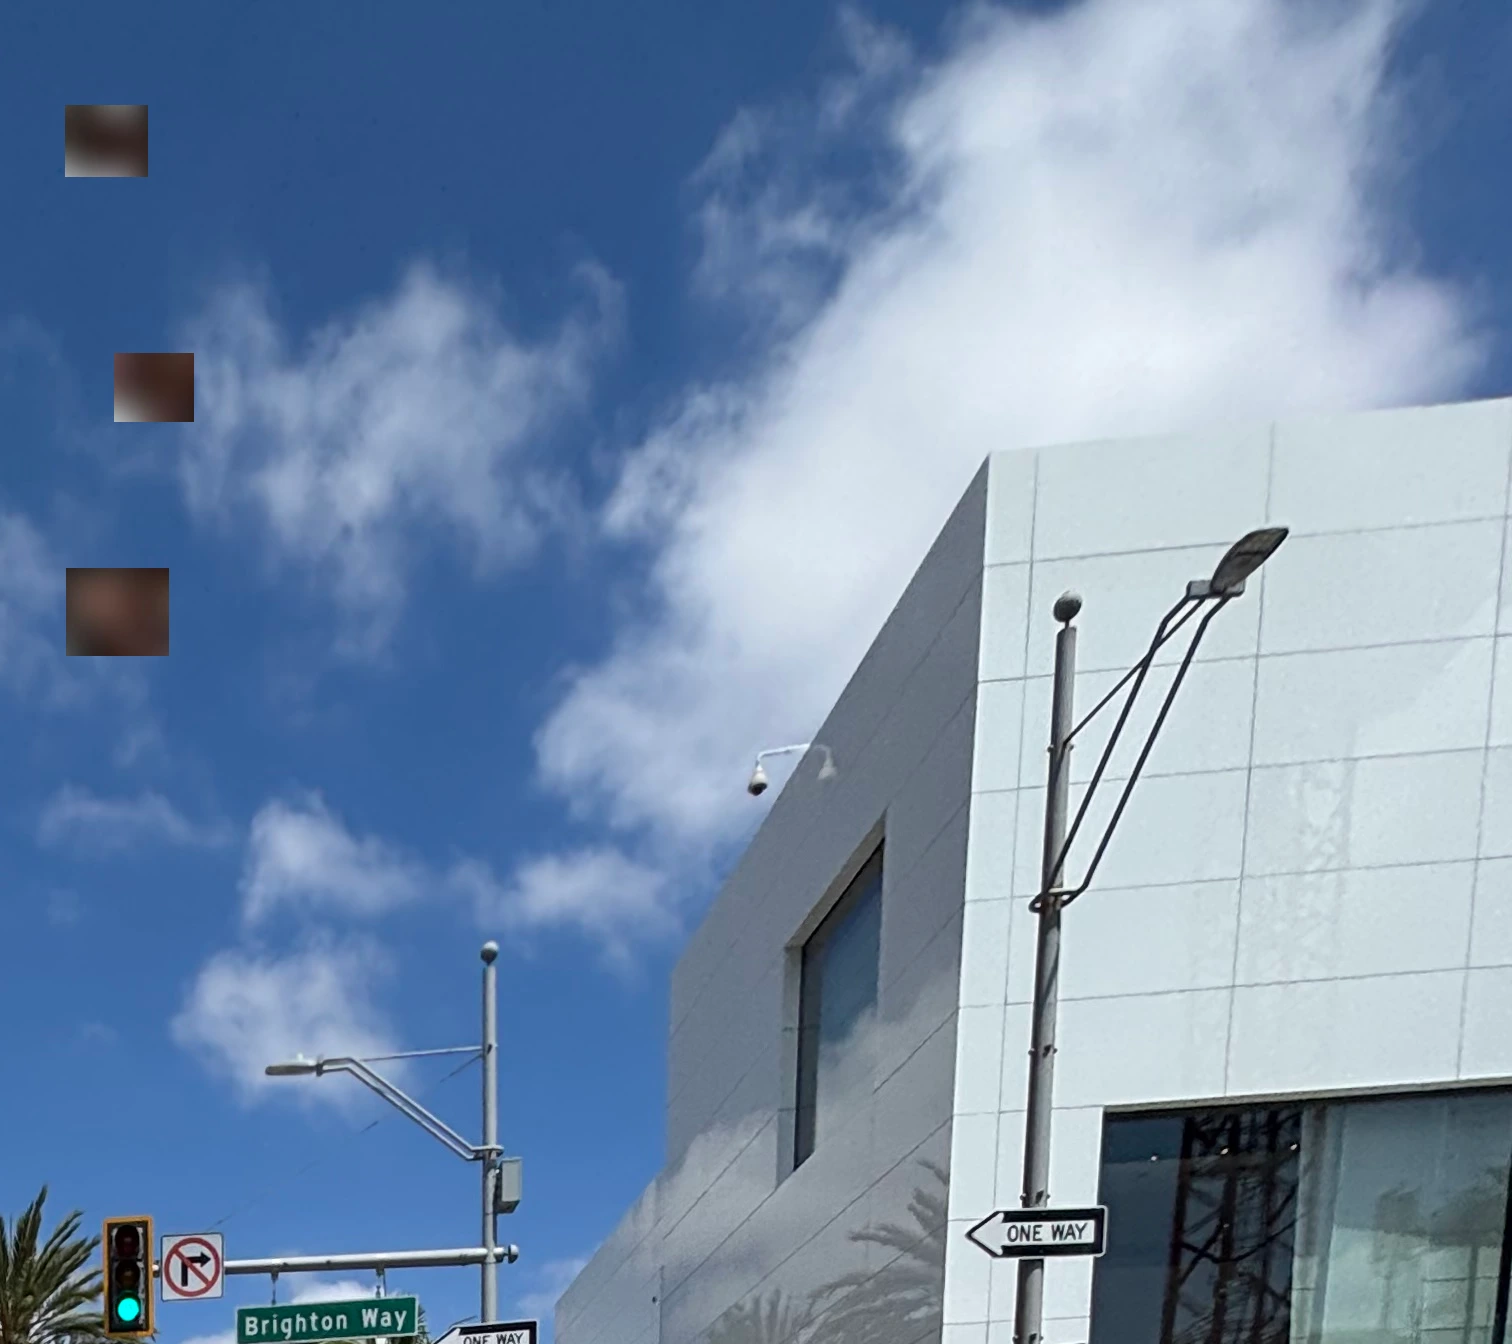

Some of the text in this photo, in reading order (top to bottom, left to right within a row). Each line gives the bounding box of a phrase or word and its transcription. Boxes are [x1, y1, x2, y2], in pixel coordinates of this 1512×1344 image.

[1007, 1222, 1088, 1243] ONE WAY
[244, 1306, 409, 1340] Brighton Way
